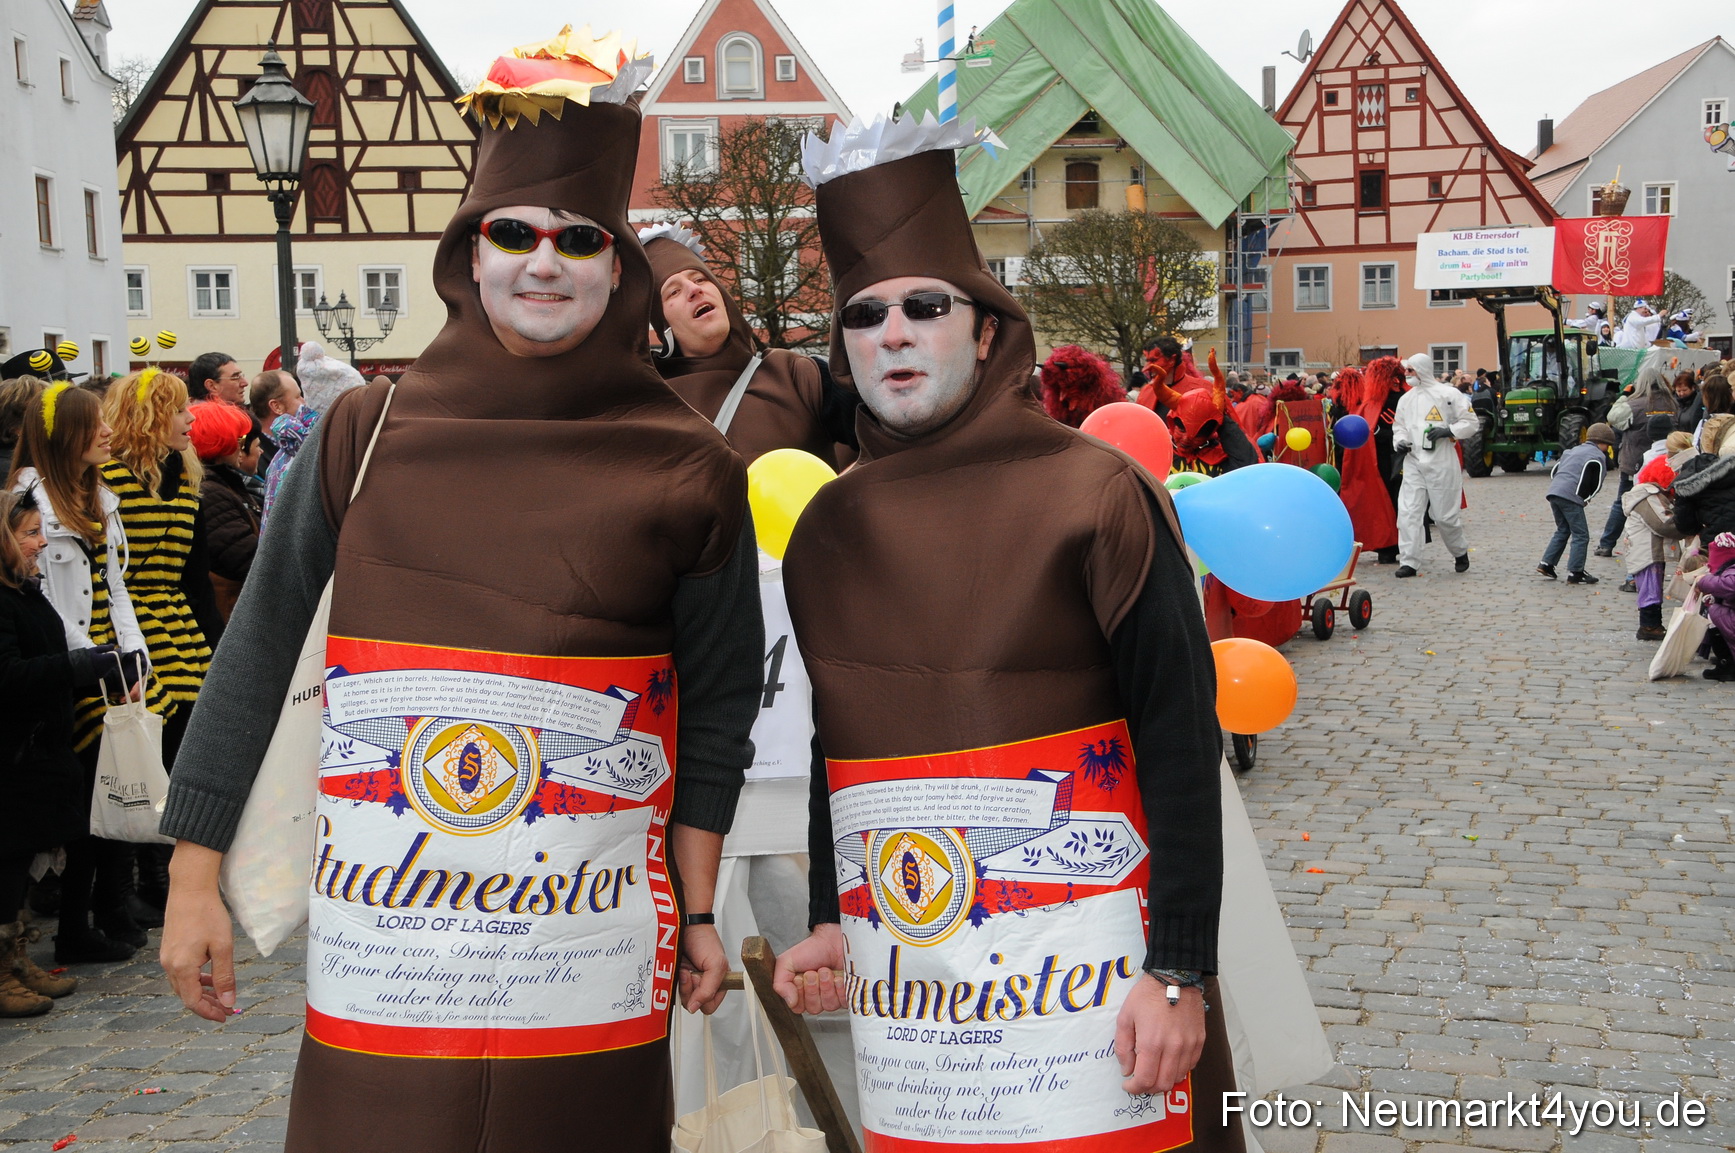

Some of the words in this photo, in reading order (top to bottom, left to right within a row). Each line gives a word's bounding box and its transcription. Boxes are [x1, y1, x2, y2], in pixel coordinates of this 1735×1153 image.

[648, 806, 678, 1011] GENUINE
[376, 915, 427, 931] LORD
[430, 917, 457, 932] OF
[460, 920, 532, 936] LAGERS
[322, 932, 360, 951] when
[358, 943, 398, 959] you
[402, 948, 439, 960] can,
[449, 941, 507, 960] Drink
[512, 944, 558, 961] when
[556, 948, 602, 966] your
[605, 937, 636, 957] able
[322, 952, 344, 975] If
[336, 964, 380, 979] your
[385, 963, 465, 989] drinking
[469, 972, 499, 984] me,
[499, 967, 561, 990] you'll
[561, 967, 582, 983] be
[376, 988, 430, 1005] under
[435, 989, 463, 1006] the
[468, 990, 514, 1007] table
[887, 1026, 918, 1042] LORD
[920, 1029, 937, 1044] OF
[939, 1029, 1003, 1045] LAGERS
[877, 1056, 902, 1072] you
[904, 1060, 929, 1074] can,
[935, 1053, 984, 1072] Drink
[990, 1052, 1039, 1071] when
[1038, 1051, 1089, 1074] your
[1095, 1039, 1115, 1060] ab
[868, 1078, 894, 1093] your
[897, 1076, 951, 1103] drinking
[956, 1086, 985, 1099] me,
[985, 1074, 1045, 1103] you'll
[1048, 1073, 1070, 1092] be
[895, 1101, 931, 1119] under
[934, 1103, 957, 1120] the
[961, 1103, 1002, 1120] table
